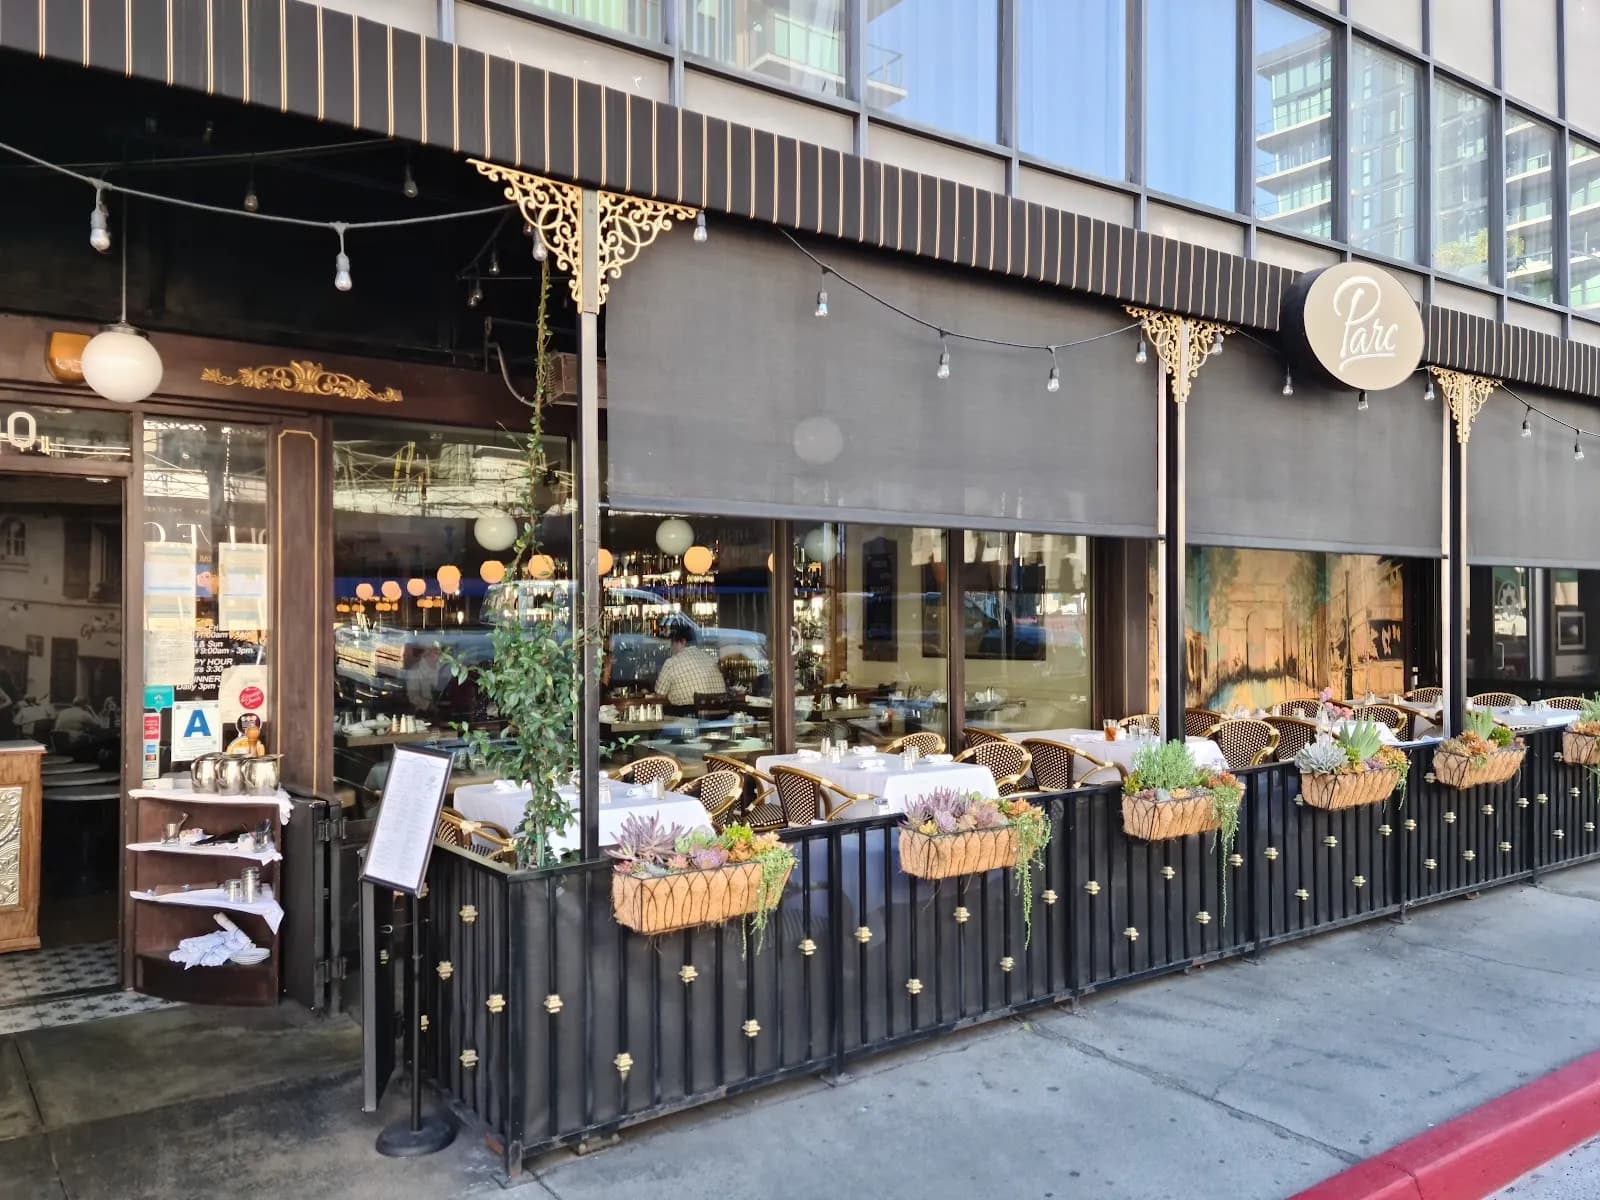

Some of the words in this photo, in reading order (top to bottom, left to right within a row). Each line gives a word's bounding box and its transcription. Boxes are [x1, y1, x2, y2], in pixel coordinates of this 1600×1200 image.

[1333, 275, 1399, 360] Parc
[207, 640, 224, 648] Sun
[200, 647, 230, 655] 9:00am
[206, 665, 224, 673] 3:30
[194, 675, 221, 683] INNER
[198, 683, 216, 691] 3pm
[183, 709, 212, 738] A
